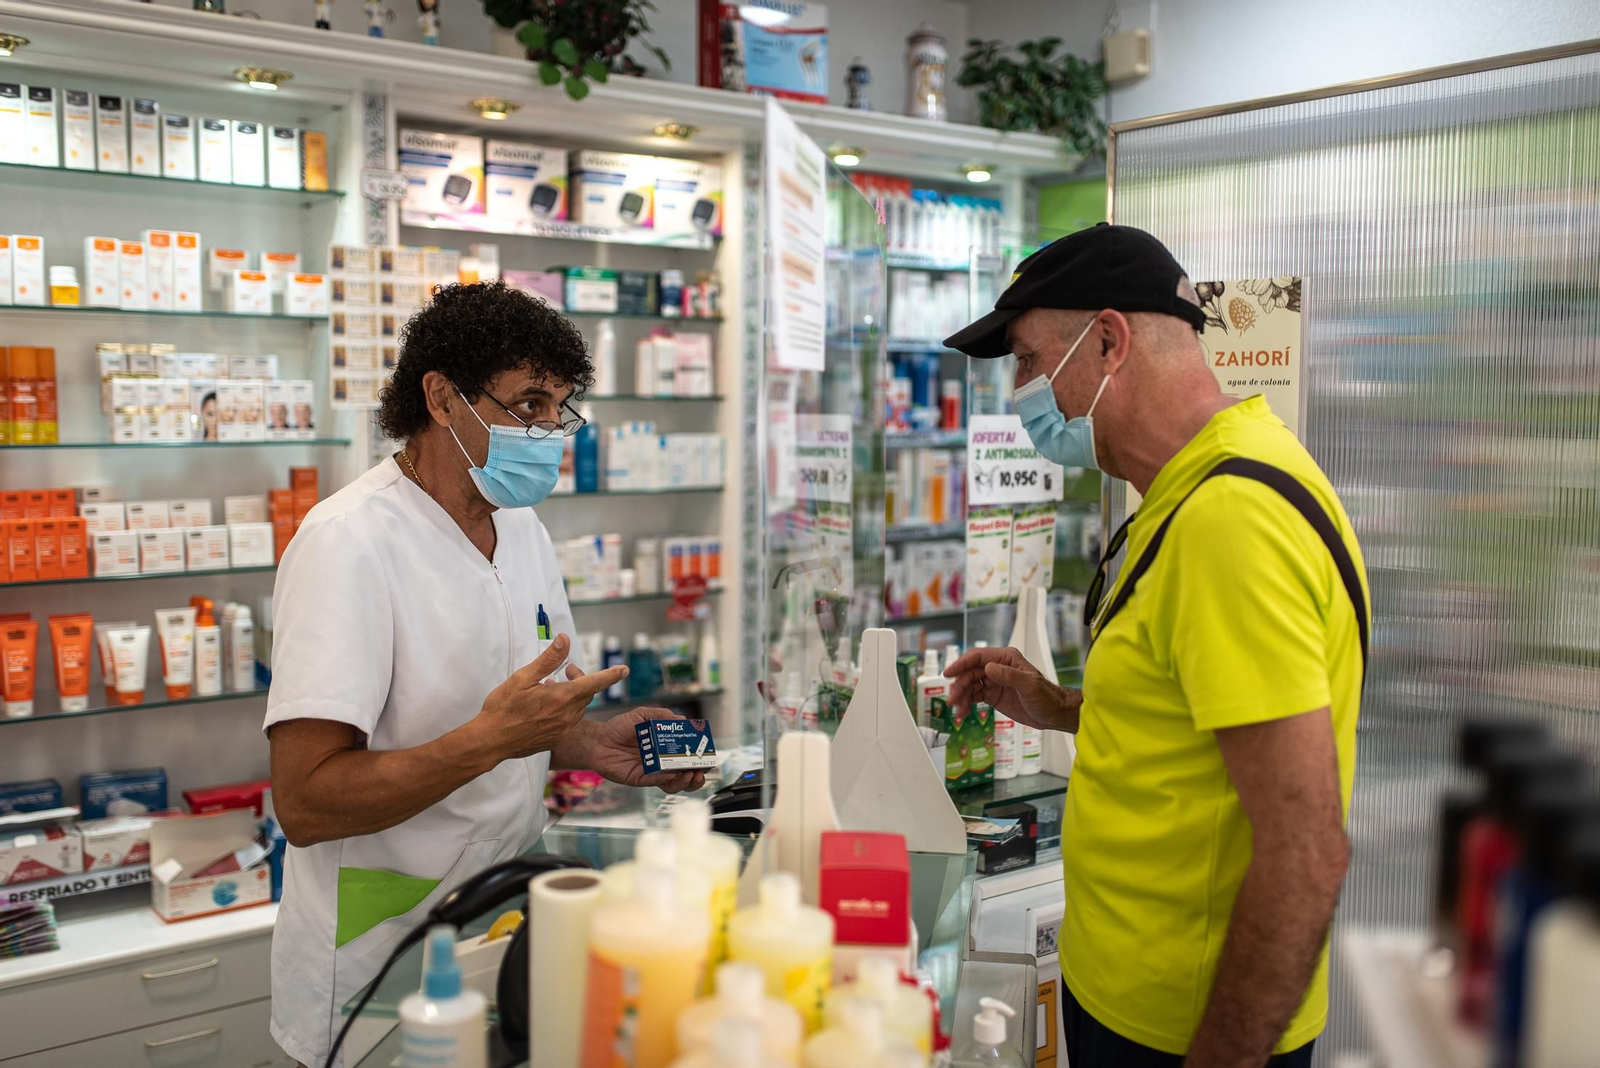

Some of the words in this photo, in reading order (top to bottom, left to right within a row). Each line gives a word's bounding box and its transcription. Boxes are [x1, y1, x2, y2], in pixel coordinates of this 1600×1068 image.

[1214, 346, 1291, 367] ZAHORÍ
[1227, 379, 1247, 388] agua
[1249, 378, 1259, 386] de
[1260, 378, 1291, 386] colonia
[999, 470, 1038, 488] 10,95€
[9, 878, 97, 903] RESFRIADO
[101, 876, 112, 887] Y
